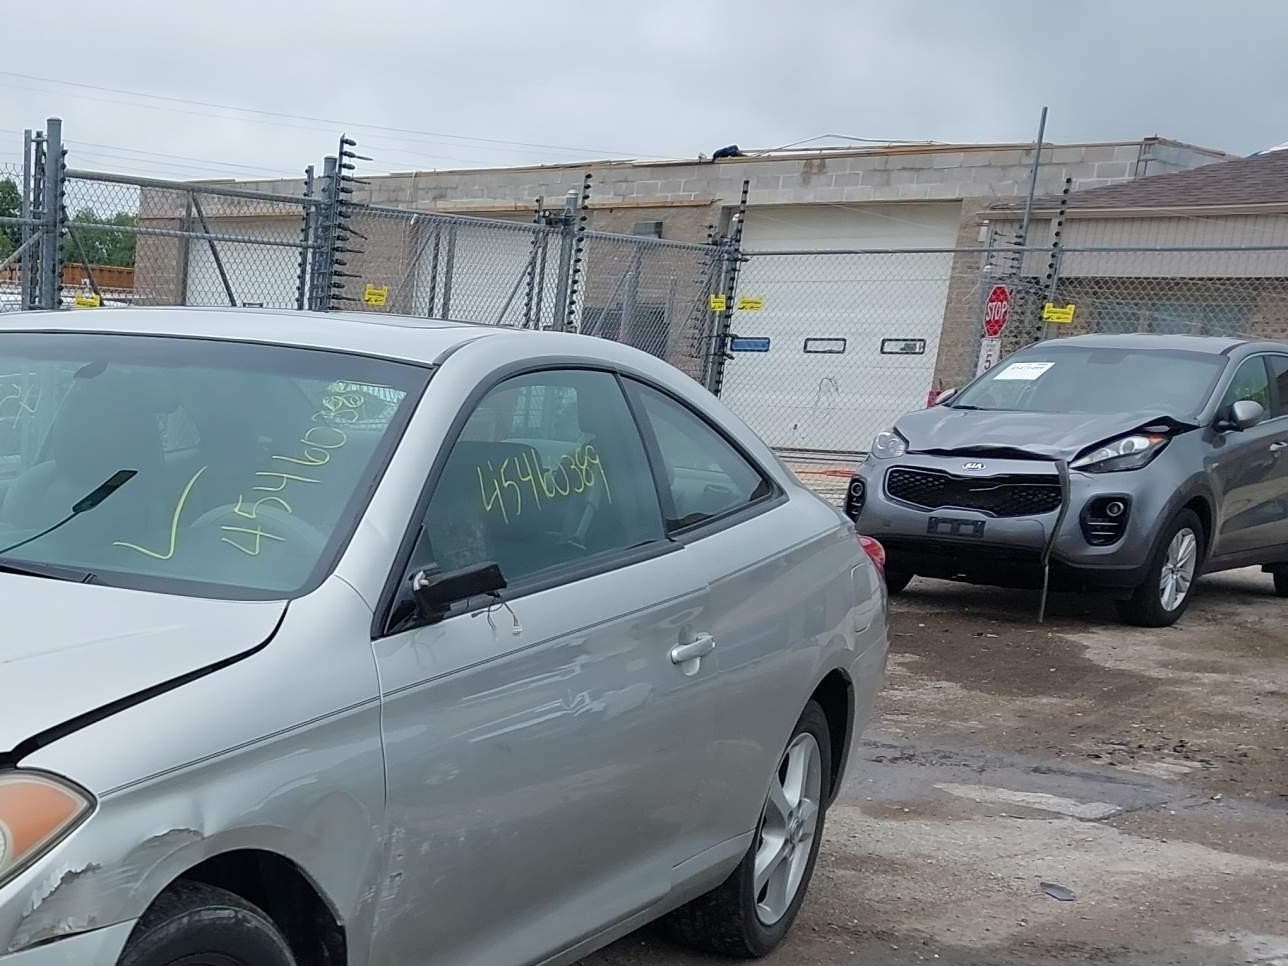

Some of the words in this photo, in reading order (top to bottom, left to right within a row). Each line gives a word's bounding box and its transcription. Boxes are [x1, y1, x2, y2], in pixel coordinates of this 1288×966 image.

[986, 301, 1008, 321] STOP
[984, 353, 992, 370] 5
[476, 445, 612, 525] 45460389
